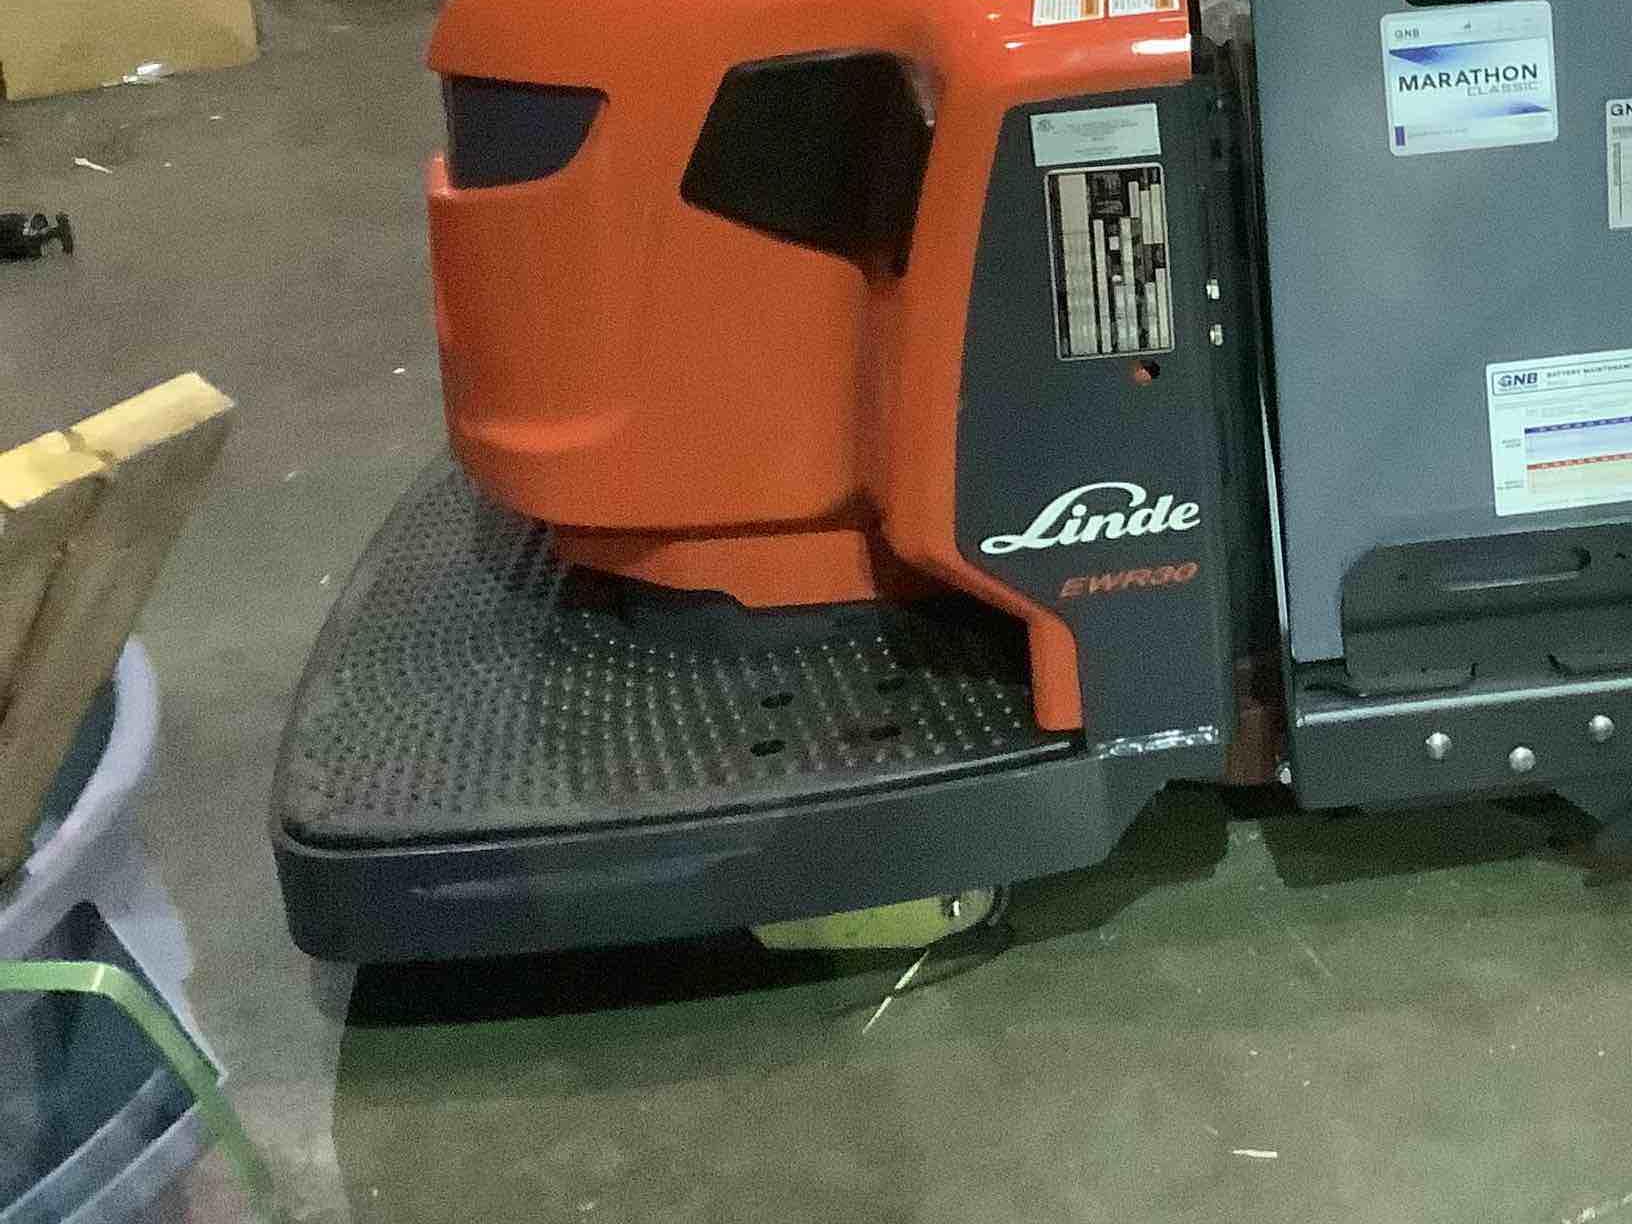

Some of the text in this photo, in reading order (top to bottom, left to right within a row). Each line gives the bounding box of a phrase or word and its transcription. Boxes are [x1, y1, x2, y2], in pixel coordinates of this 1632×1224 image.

[1398, 63, 1538, 93] MARATHON
[1466, 80, 1539, 97] CLASSIC
[1497, 371, 1538, 388] GNB
[980, 481, 1201, 555] Linde
